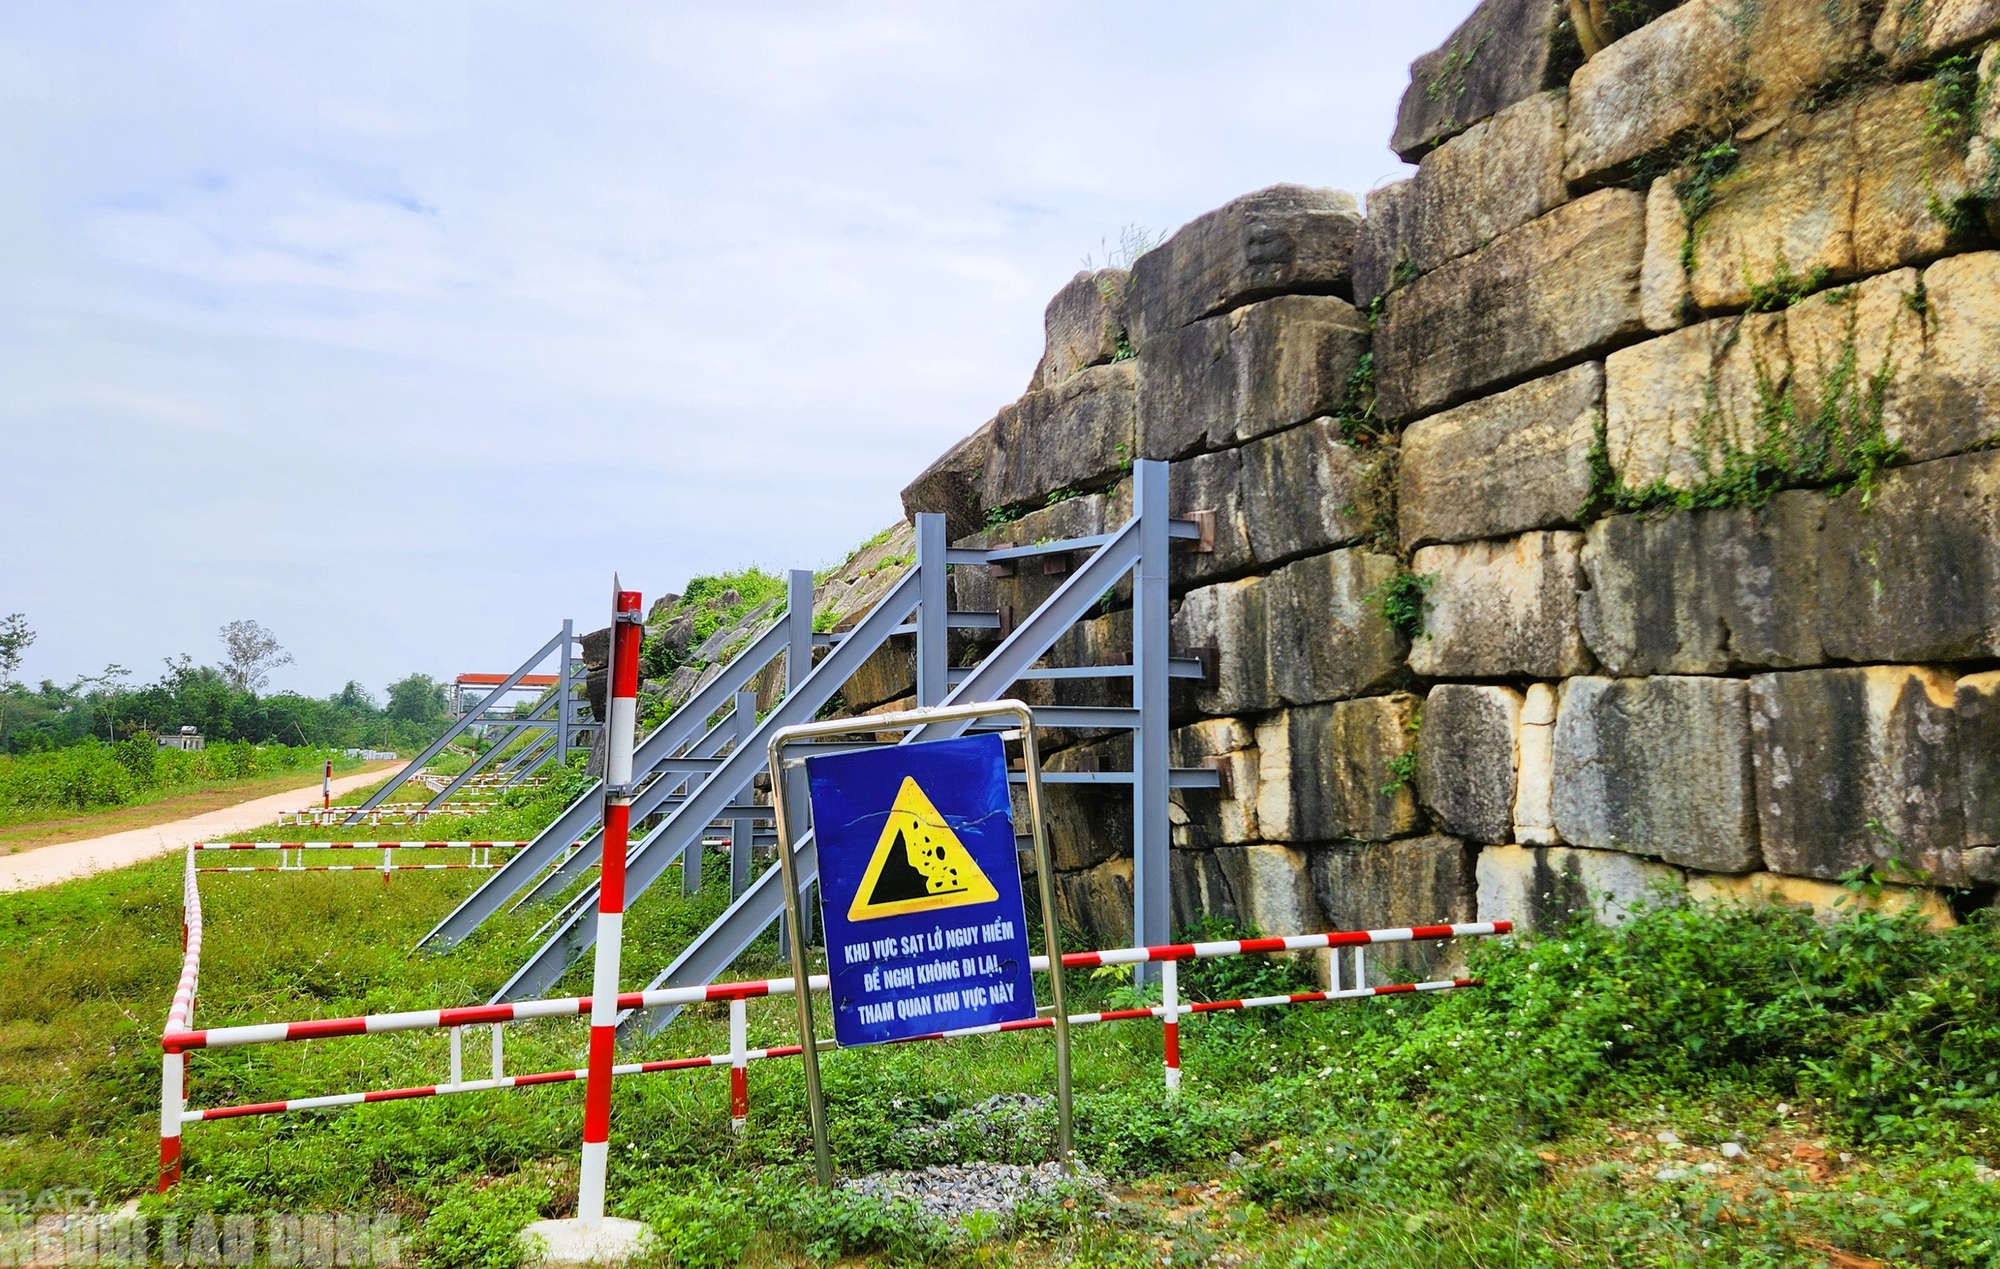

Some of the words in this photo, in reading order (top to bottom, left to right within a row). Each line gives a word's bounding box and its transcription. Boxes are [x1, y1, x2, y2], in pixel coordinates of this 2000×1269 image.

[844, 943, 870, 964] KHU
[872, 936, 898, 962] VỰC
[901, 934, 924, 957] SẠT
[928, 926, 943, 952] LỞ
[945, 926, 979, 951] NGUY
[981, 916, 1015, 943] HIỂM
[863, 966, 881, 993] ĐỀ
[883, 966, 915, 990] NGHỊ
[916, 959, 961, 985] KHÔNG
[962, 959, 977, 978] ĐI
[858, 1002, 895, 1025] THAM
[897, 998, 932, 1021] QUAN
[933, 992, 960, 1013] KHU
[961, 985, 987, 1013] VỰC
[989, 980, 1015, 1005] NÀY
